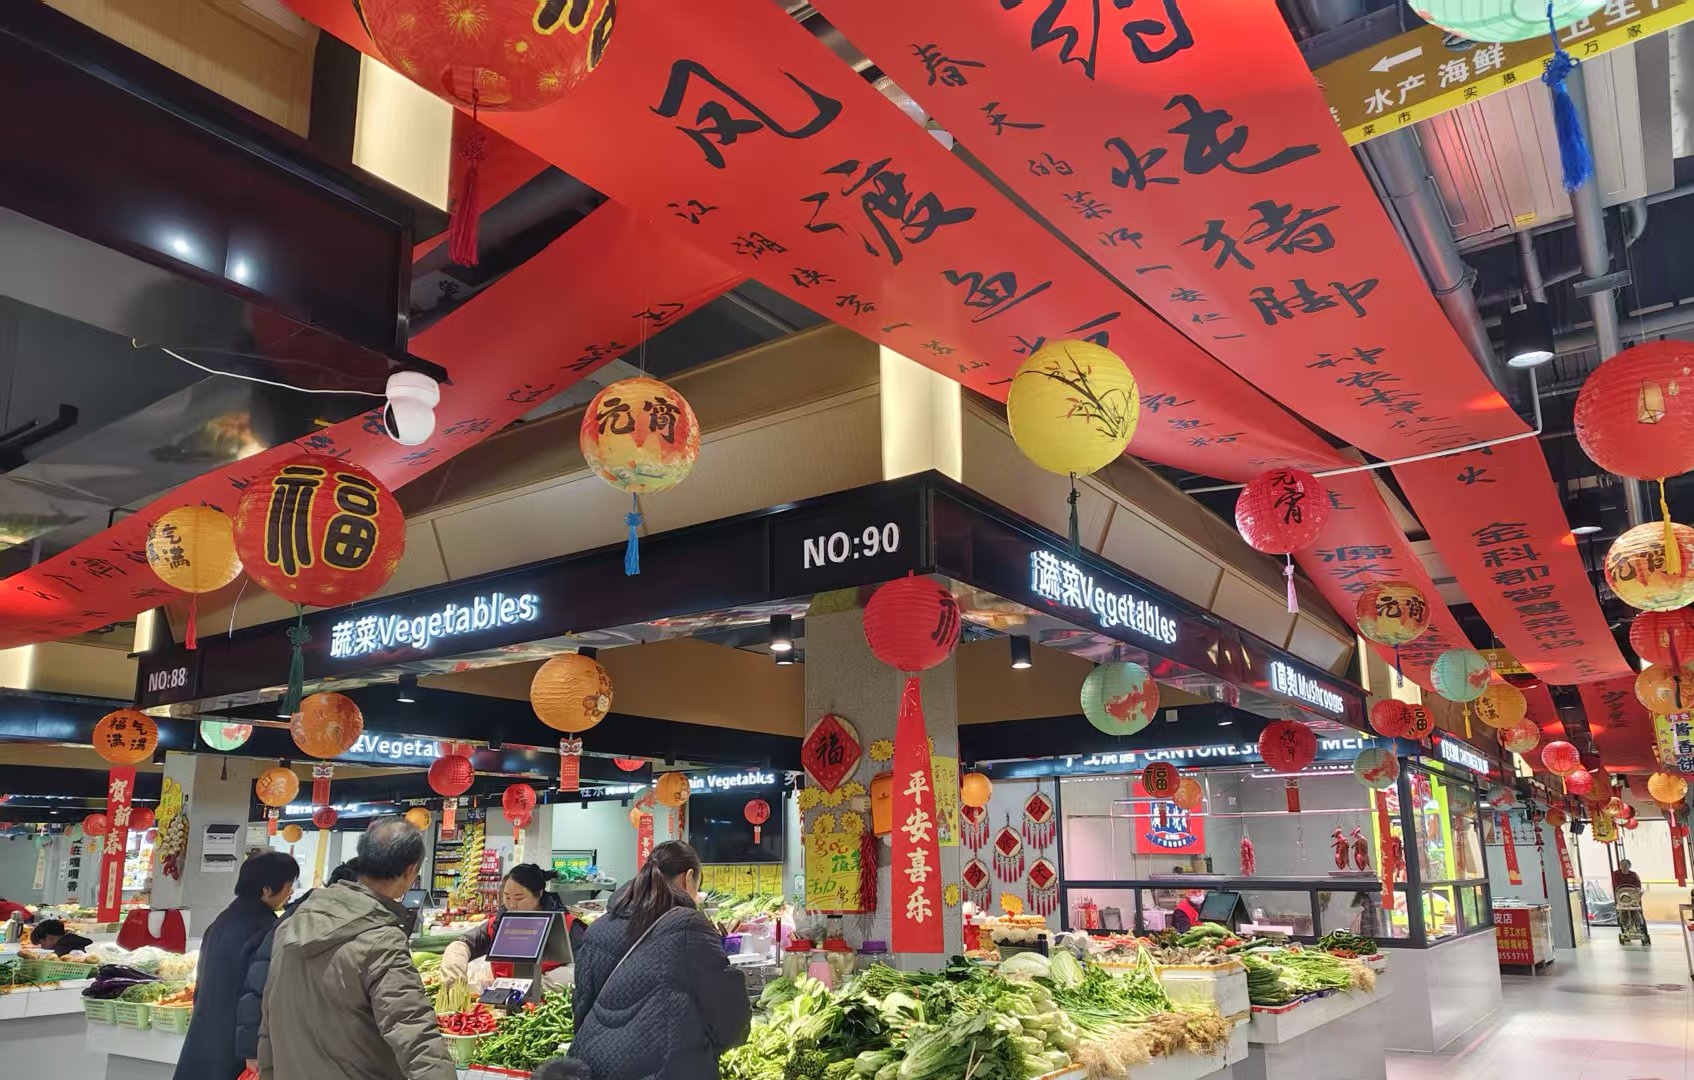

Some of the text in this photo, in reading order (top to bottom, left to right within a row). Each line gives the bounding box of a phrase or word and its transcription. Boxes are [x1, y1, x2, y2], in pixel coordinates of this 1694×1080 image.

[1364, 42, 1506, 115] 水产 海鲜
[595, 397, 682, 445] 元宵
[264, 464, 383, 579] 福
[1271, 471, 1306, 525] 元宵
[802, 521, 900, 569] NO:90
[1376, 595, 1426, 623] 元宵
[148, 667, 188, 693] NO:88
[815, 732, 845, 769] 福
[103, 778, 132, 857] 贺新春
[900, 770, 934, 923] 平安喜乐
